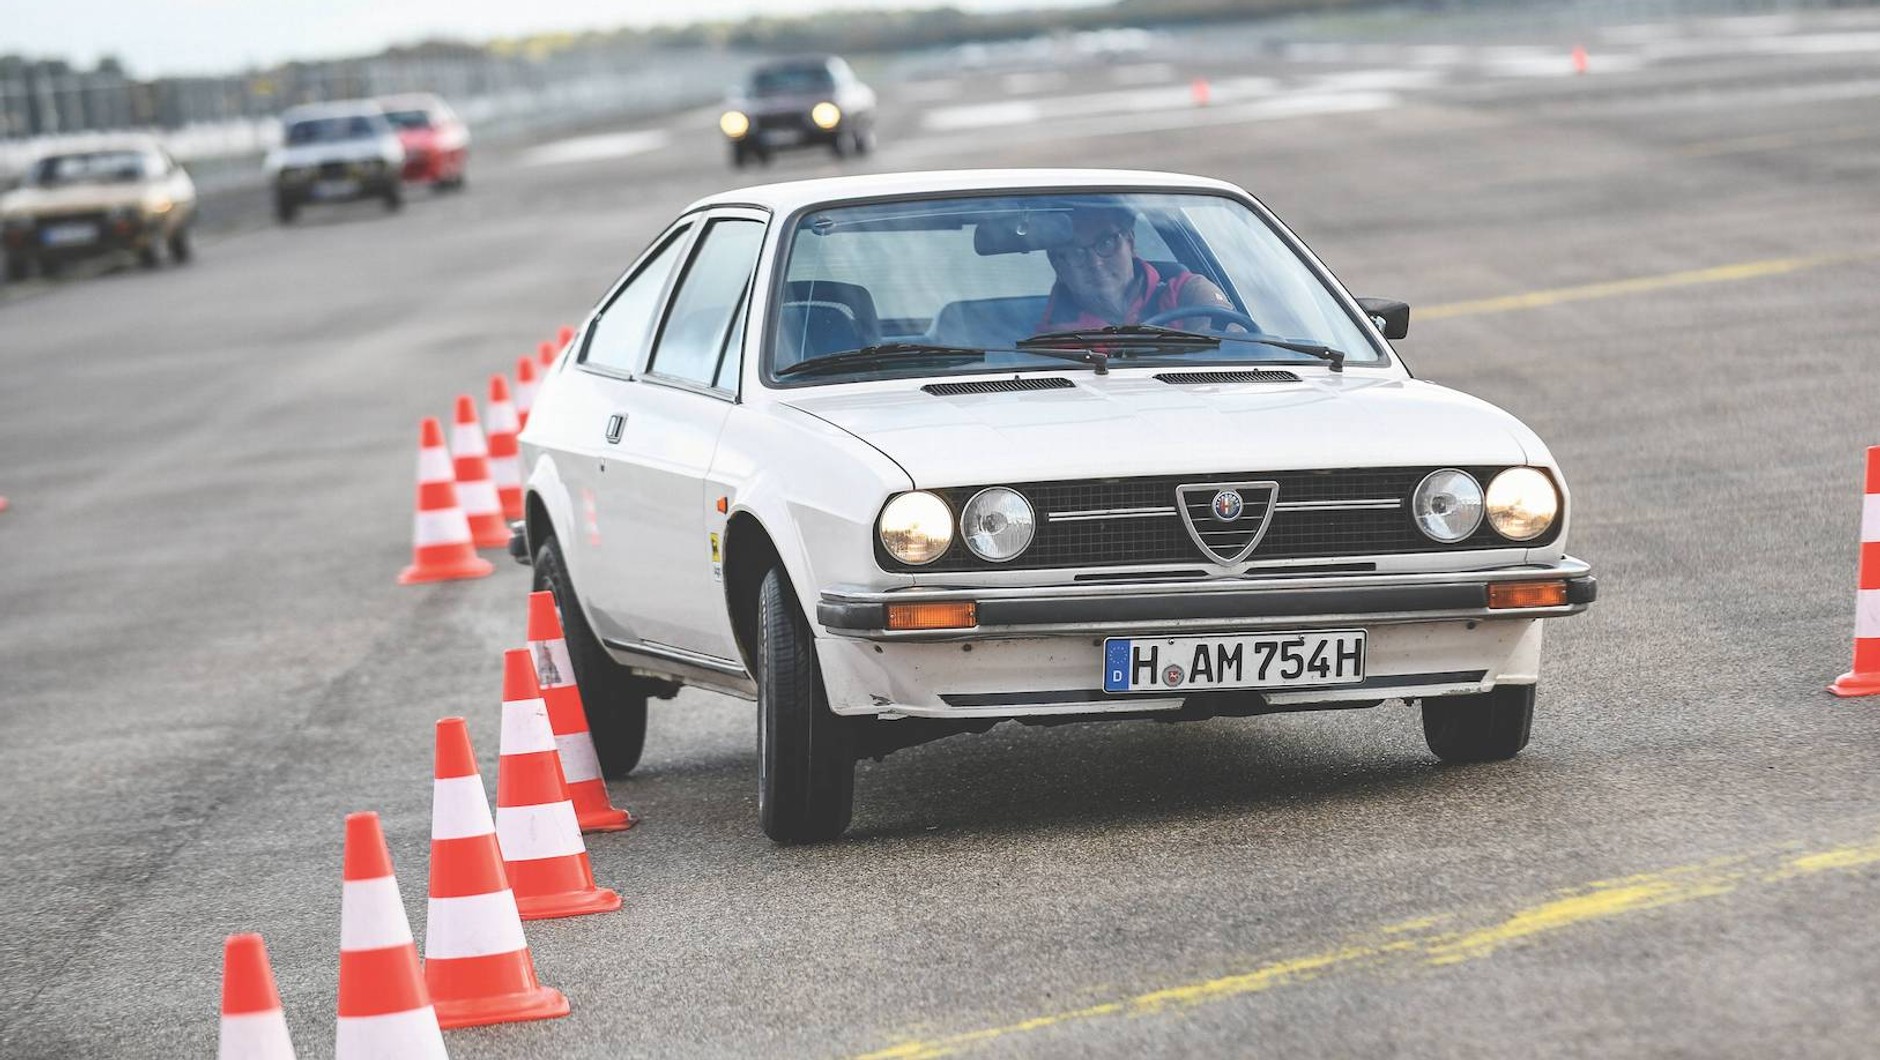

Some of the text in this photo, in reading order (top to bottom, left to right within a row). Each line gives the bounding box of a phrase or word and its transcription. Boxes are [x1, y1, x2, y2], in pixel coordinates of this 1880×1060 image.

[1132, 638, 1363, 685] H AM 754H
[1113, 671, 1122, 683] D
